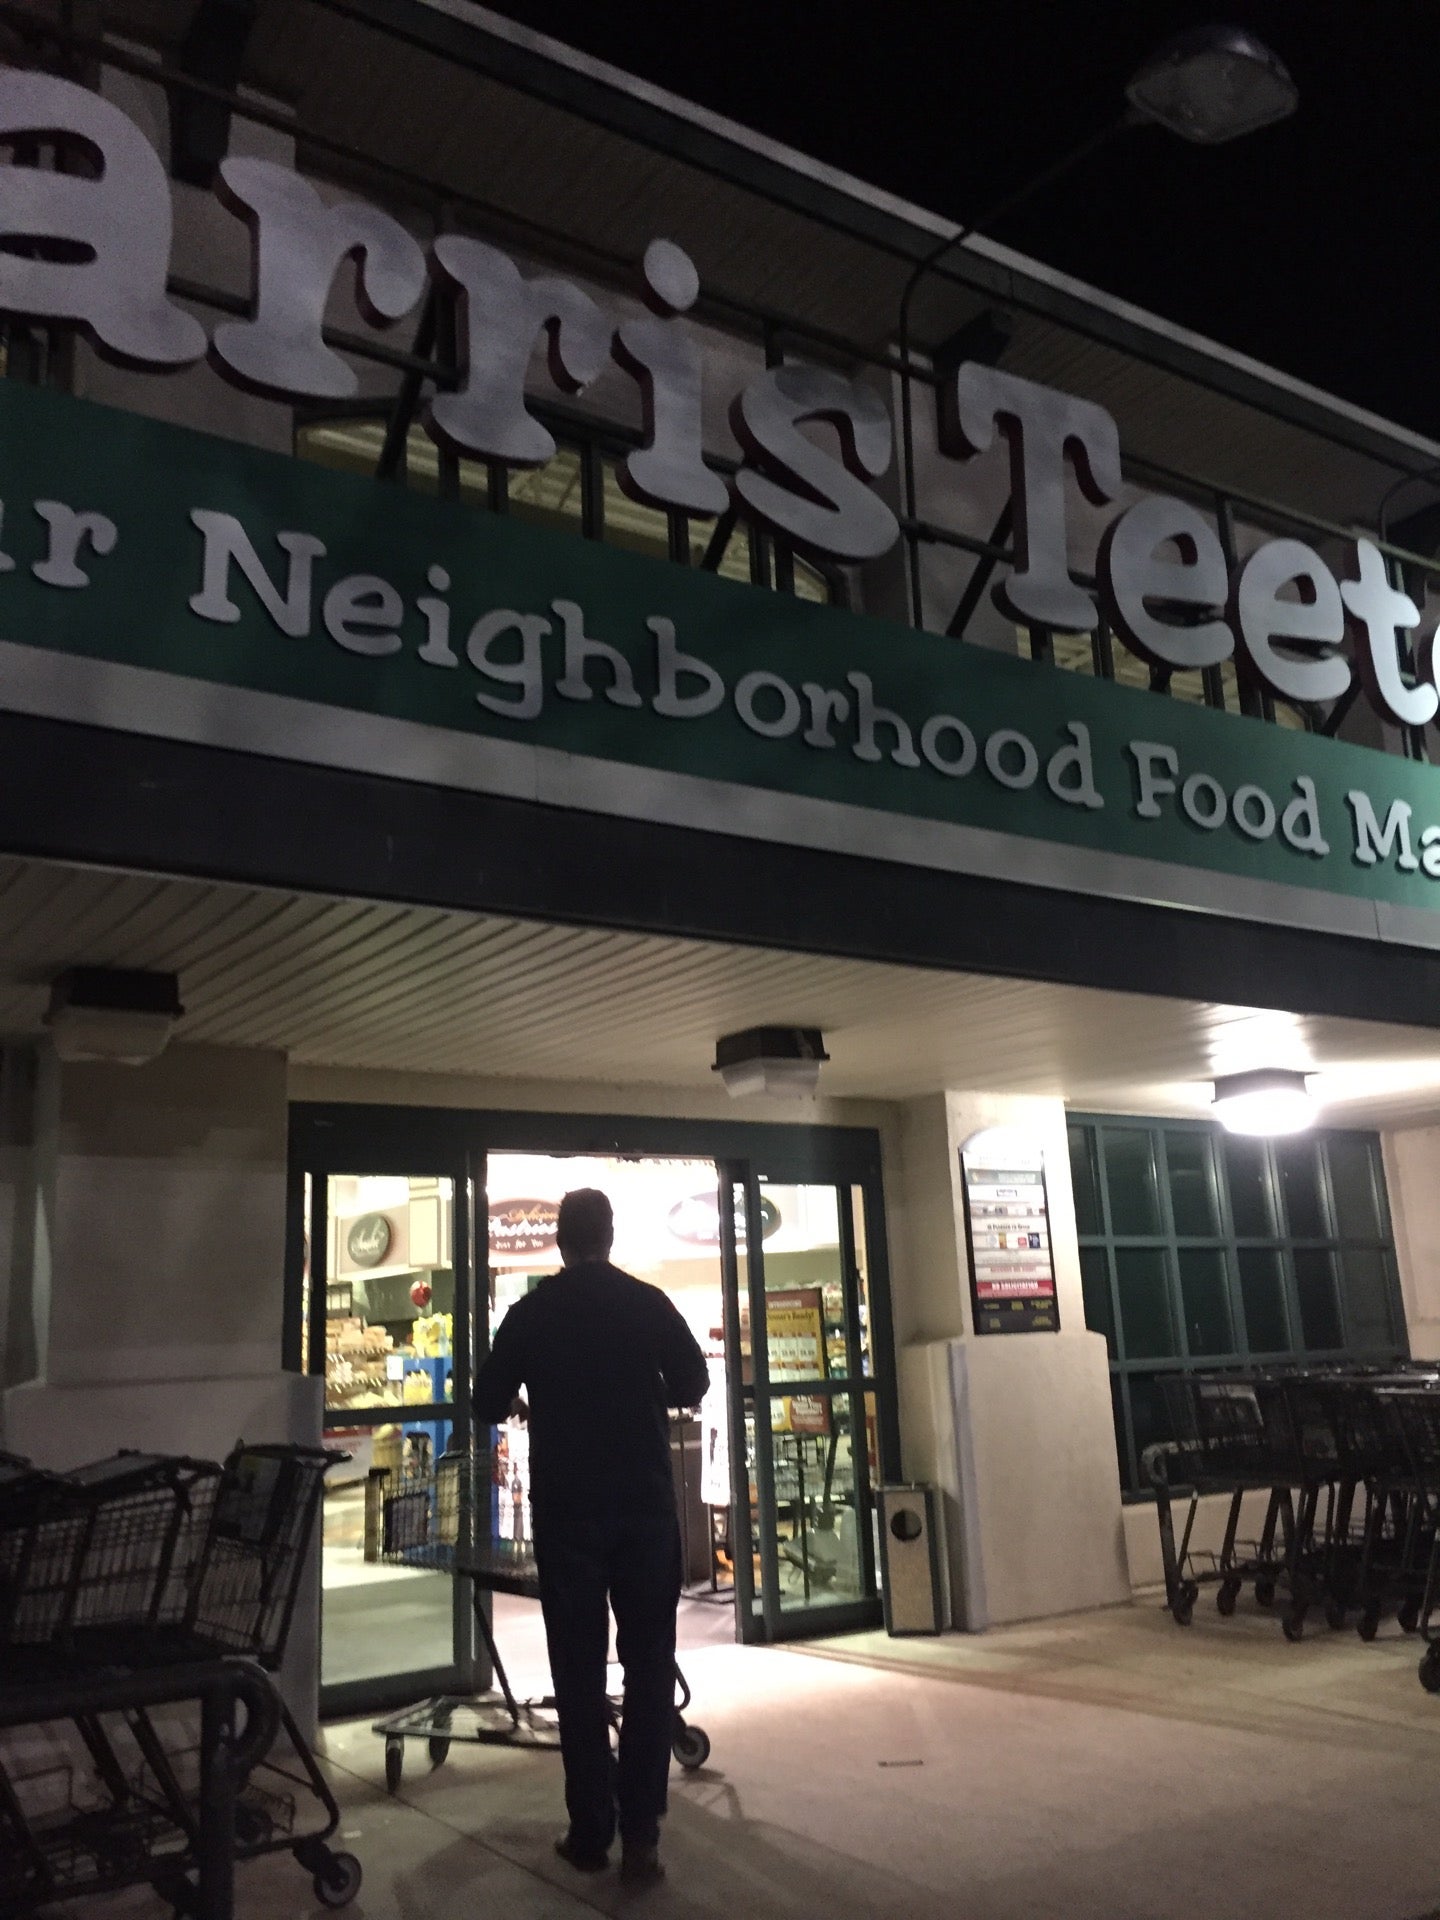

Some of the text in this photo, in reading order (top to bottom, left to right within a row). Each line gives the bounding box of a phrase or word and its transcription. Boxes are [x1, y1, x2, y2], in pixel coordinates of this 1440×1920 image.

[189, 509, 1104, 810] Neighborhood
[1128, 740, 1330, 856] Food
[954, 360, 1440, 726] Teet
